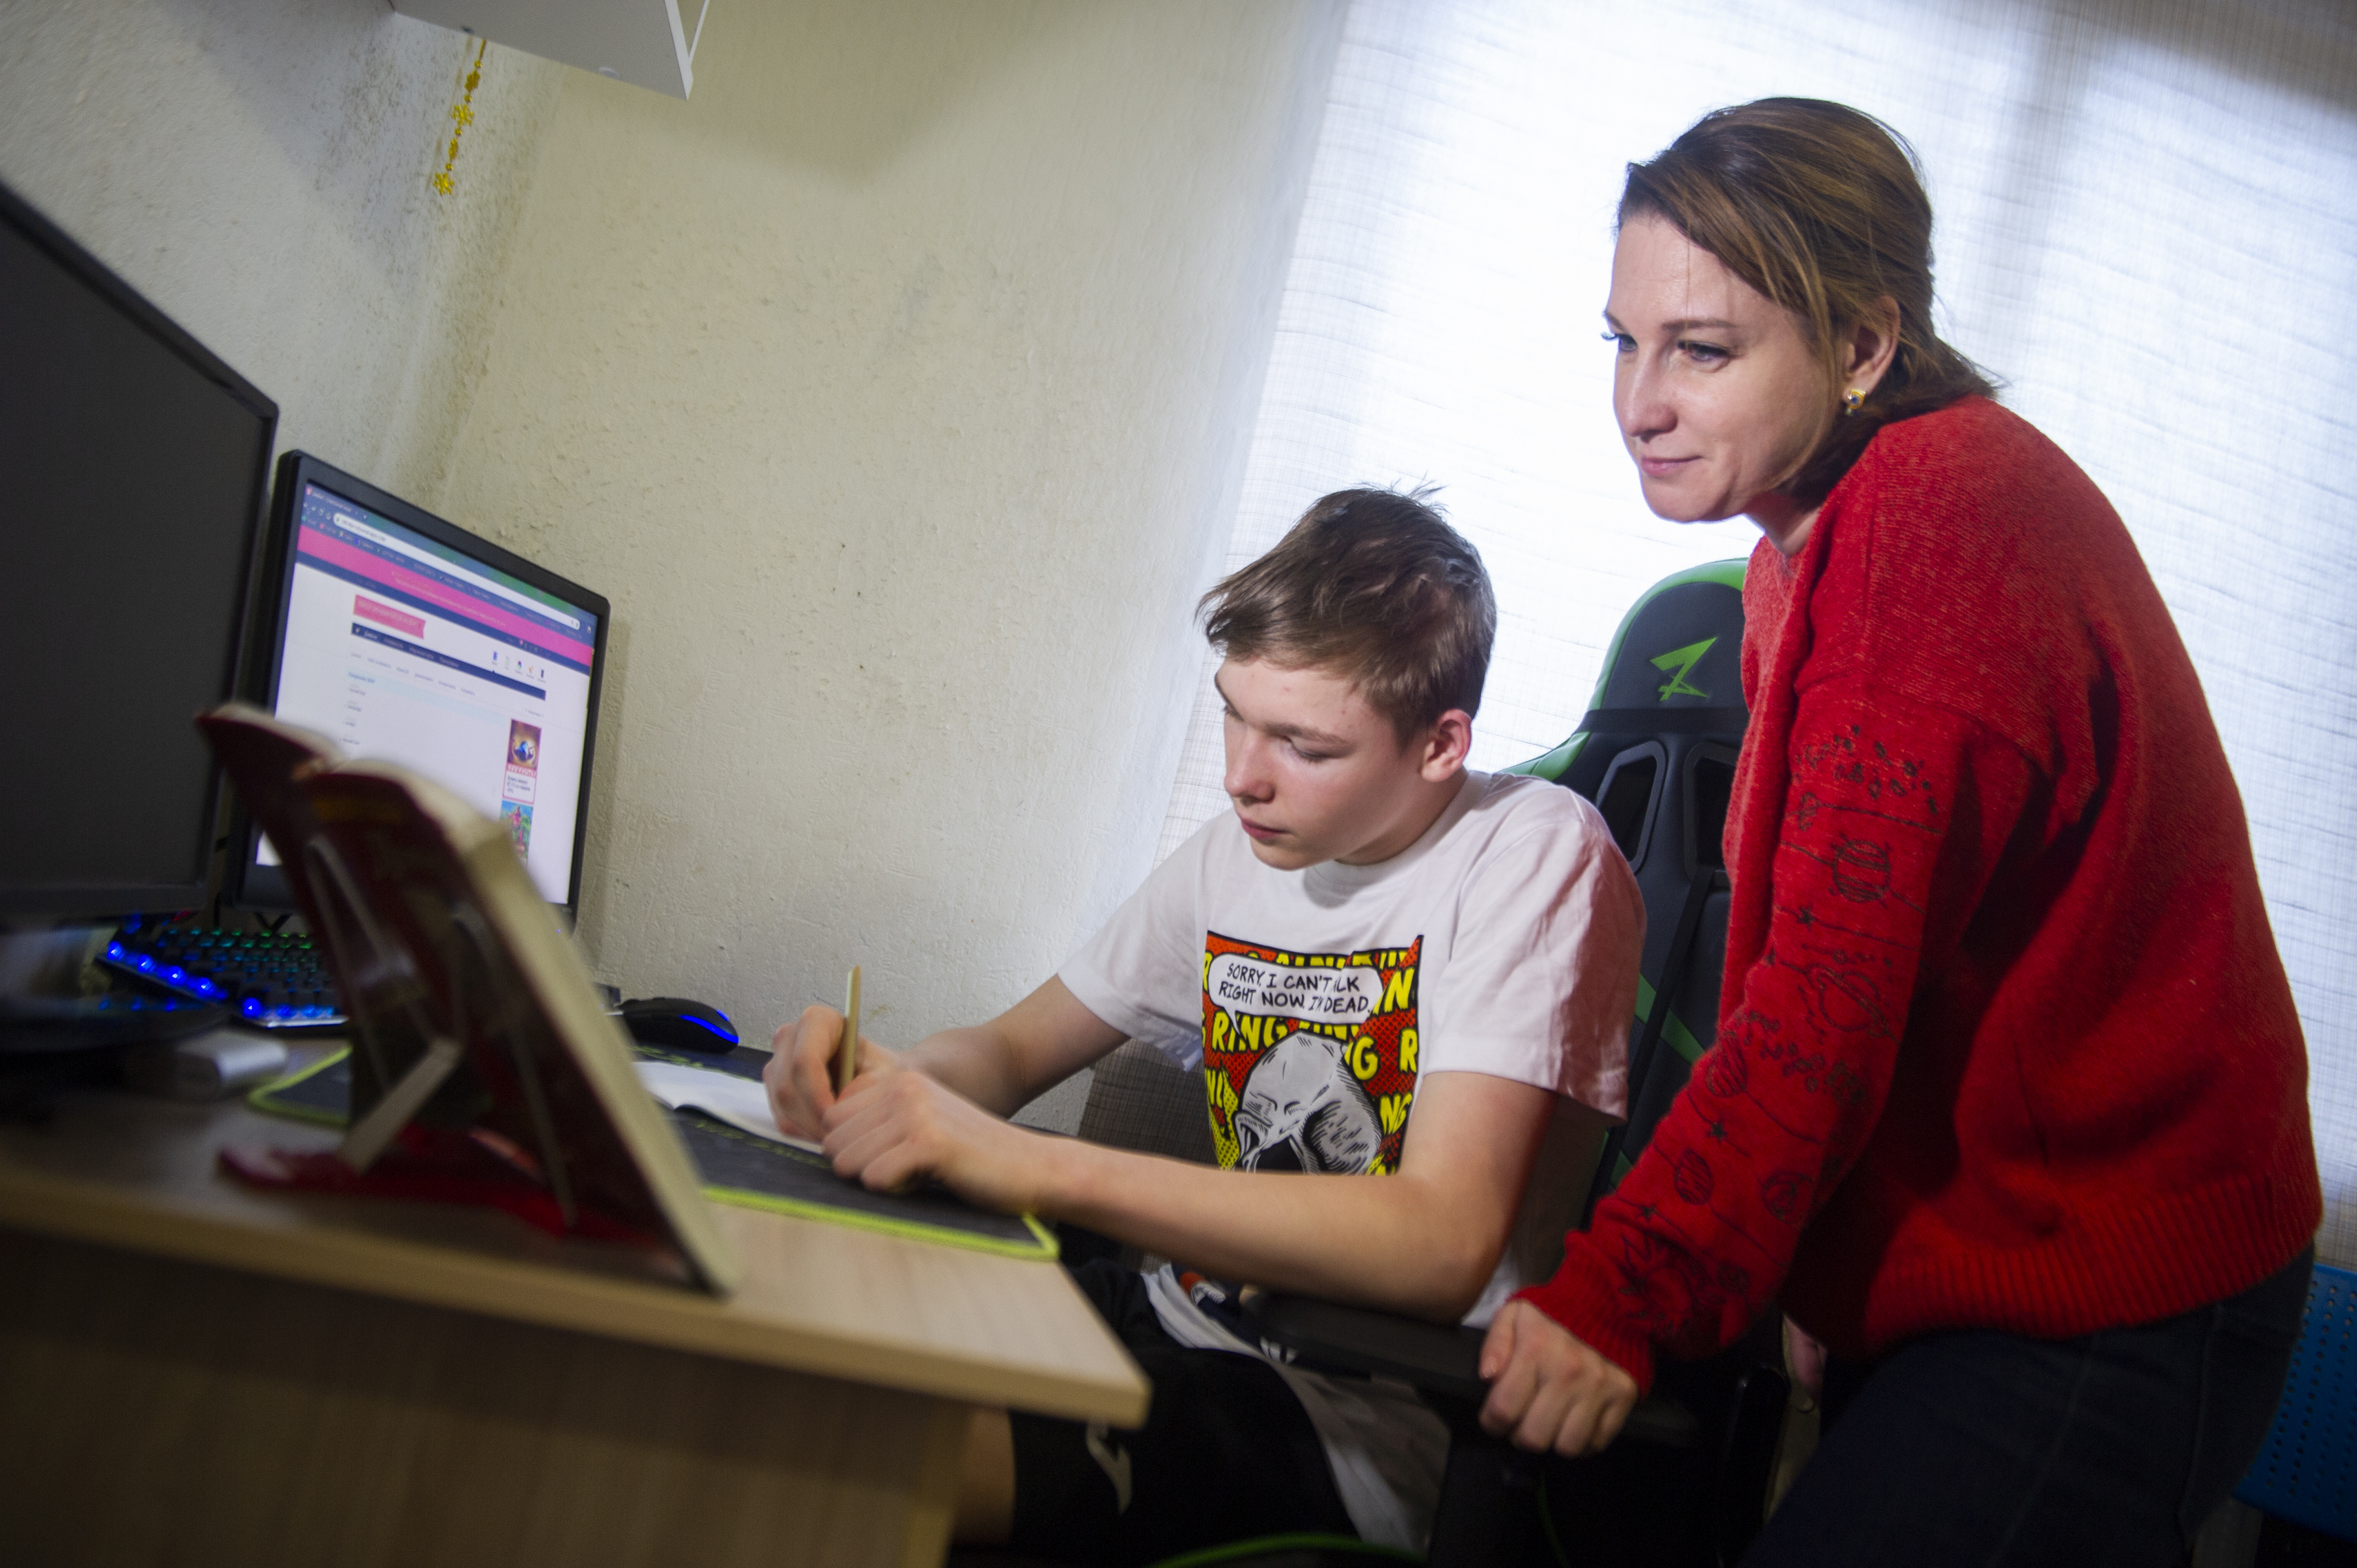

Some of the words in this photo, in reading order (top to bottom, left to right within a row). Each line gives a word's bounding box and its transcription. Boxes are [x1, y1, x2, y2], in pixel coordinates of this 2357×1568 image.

[1227, 963, 1266, 987] SORRY,
[1266, 974, 1277, 989] I
[1283, 975, 1332, 993] CAN'T
[1218, 981, 1256, 1006] RIGHT
[1261, 992, 1306, 1009] NOW.
[1323, 996, 1371, 1013] DEAD.
